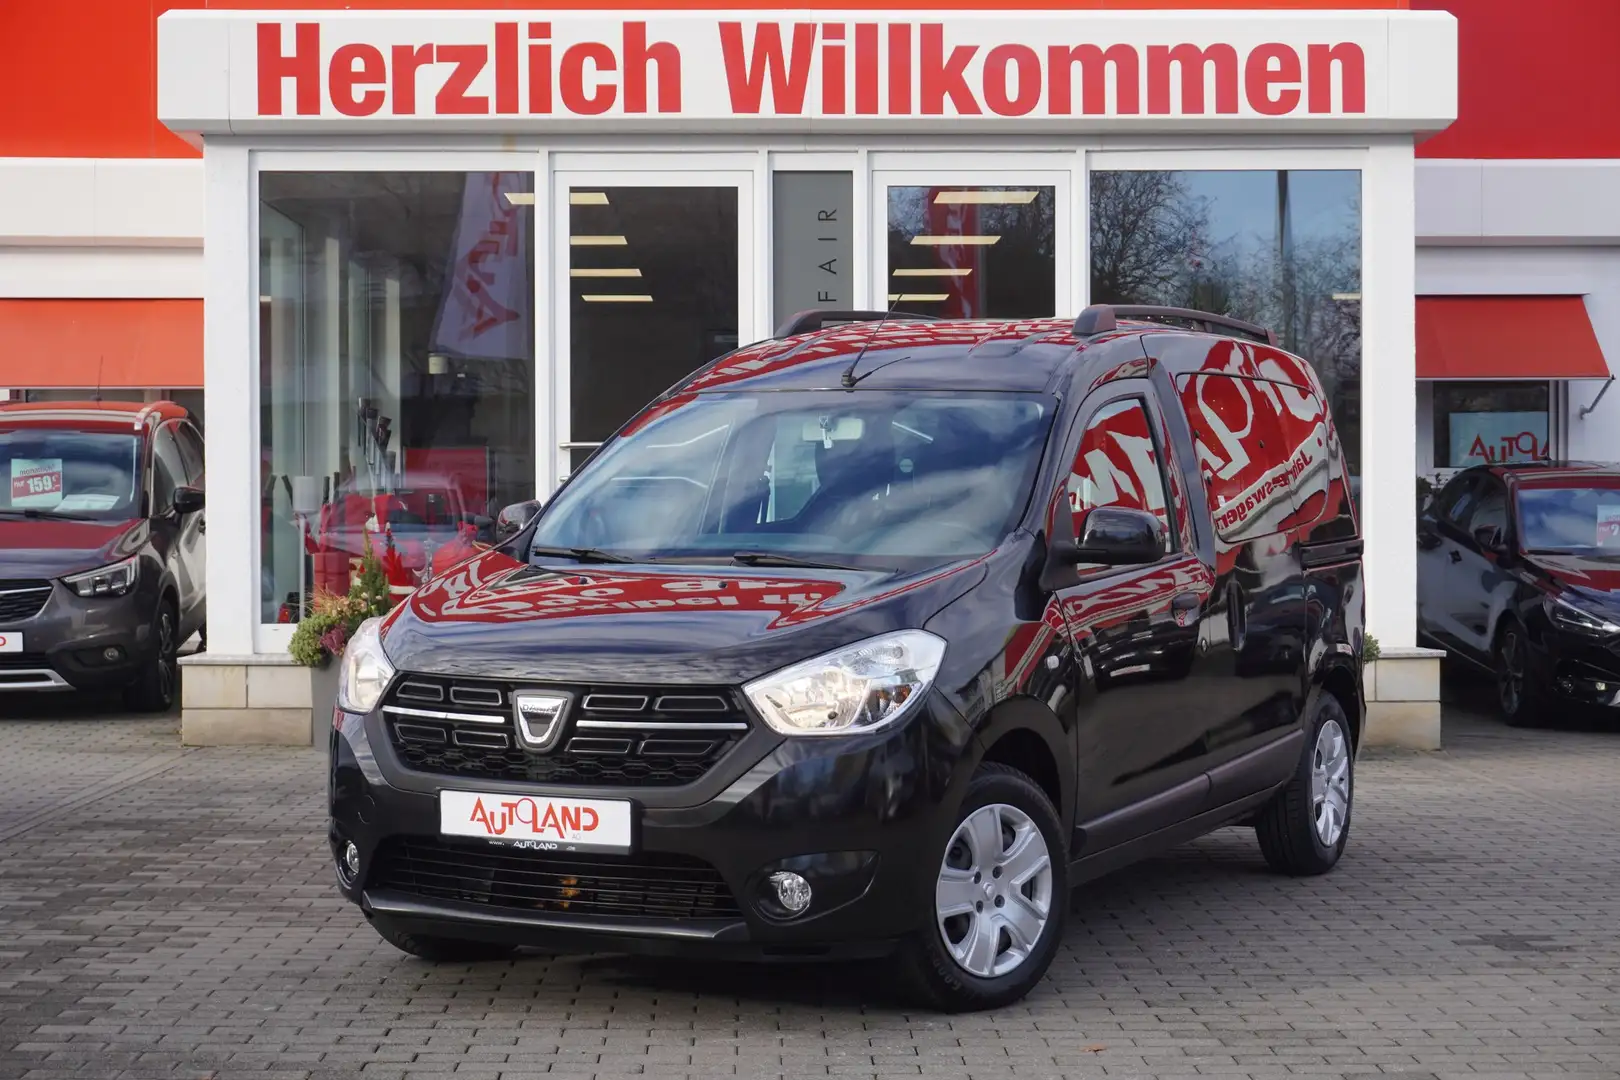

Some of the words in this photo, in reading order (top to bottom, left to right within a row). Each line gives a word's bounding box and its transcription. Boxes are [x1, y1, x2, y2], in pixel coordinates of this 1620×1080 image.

[257, 21, 681, 116] Herzlich
[719, 22, 1365, 116] Willkommen
[817, 208, 838, 302] FAIR
[470, 796, 599, 839] AUTOLAND
[513, 840, 558, 850] AUTOLAND
